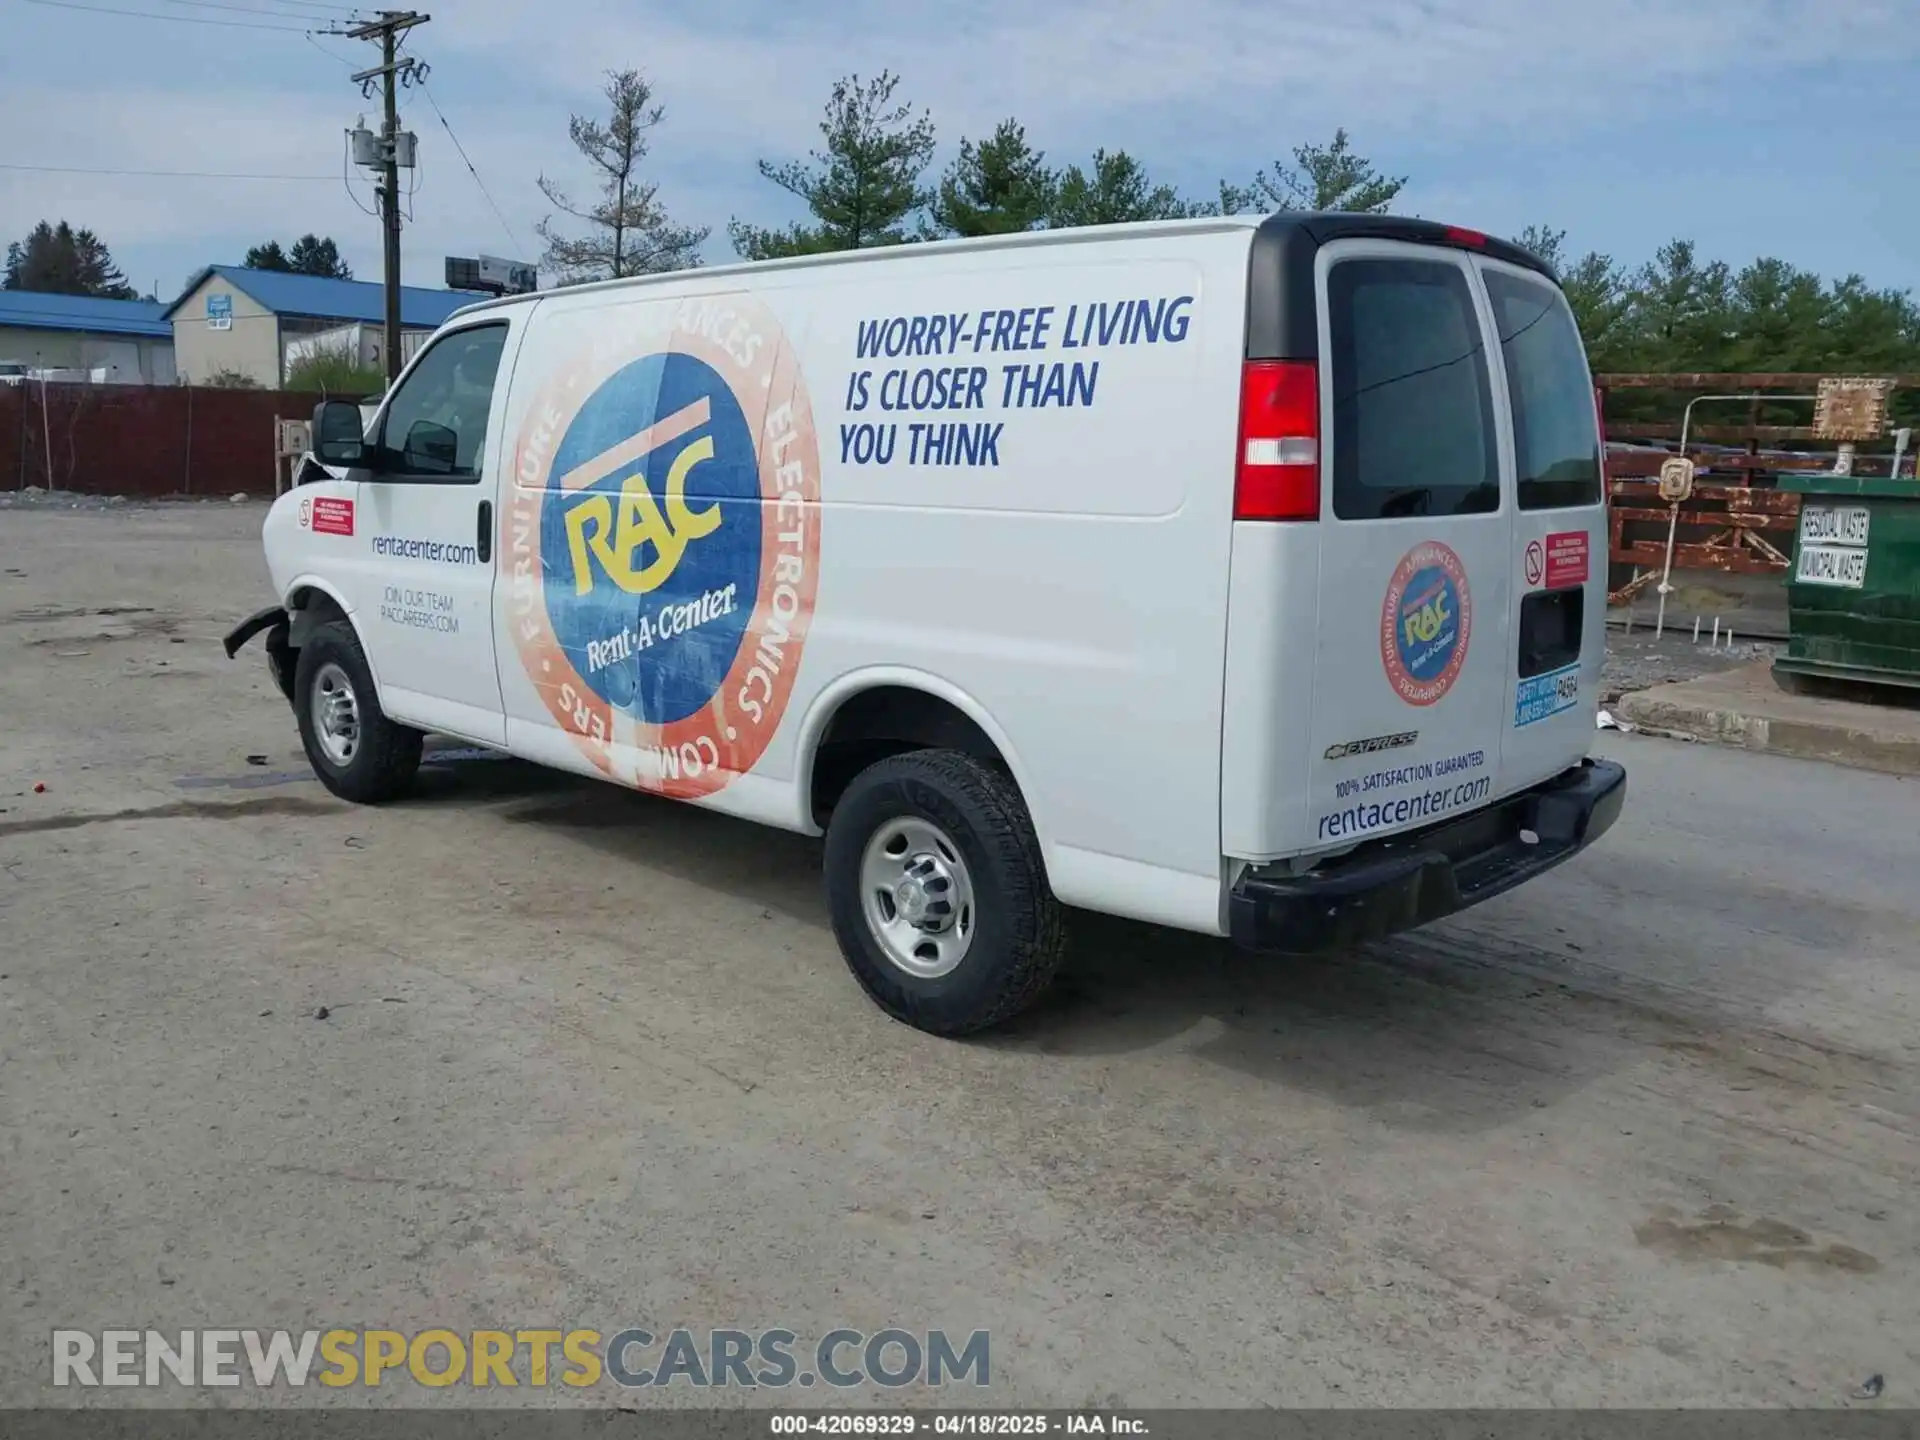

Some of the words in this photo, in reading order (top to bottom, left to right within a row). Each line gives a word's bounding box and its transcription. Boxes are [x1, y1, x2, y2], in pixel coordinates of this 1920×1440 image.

[856, 305, 1054, 359] WORRY-FREE
[1062, 295, 1194, 349] LIVING
[846, 370, 872, 411] IS
[880, 366, 988, 411] CLOSER
[1002, 361, 1099, 408] THAN
[840, 423, 897, 464] YOU
[908, 422, 1004, 466] THINK
[564, 435, 723, 595] RAC
[1804, 510, 1838, 538] RESIDUAL
[1841, 510, 1867, 540] WASTE
[372, 535, 476, 565] rentacenter.com
[738, 400, 804, 725] ELECTRONICS
[1838, 553, 1864, 581] WASTE
[383, 584, 403, 605] JOIN
[404, 588, 425, 608] OUR
[426, 591, 454, 613] TEAM
[1404, 589, 1450, 648] RAC
[557, 682, 720, 783] COMERS
[1346, 731, 1419, 756] EXPRESS
[1335, 776, 1360, 799] 100%
[1363, 763, 1433, 792] SATISFACTION
[1435, 750, 1485, 778] GUARANTEED
[1318, 775, 1491, 841] rentacenter.com
